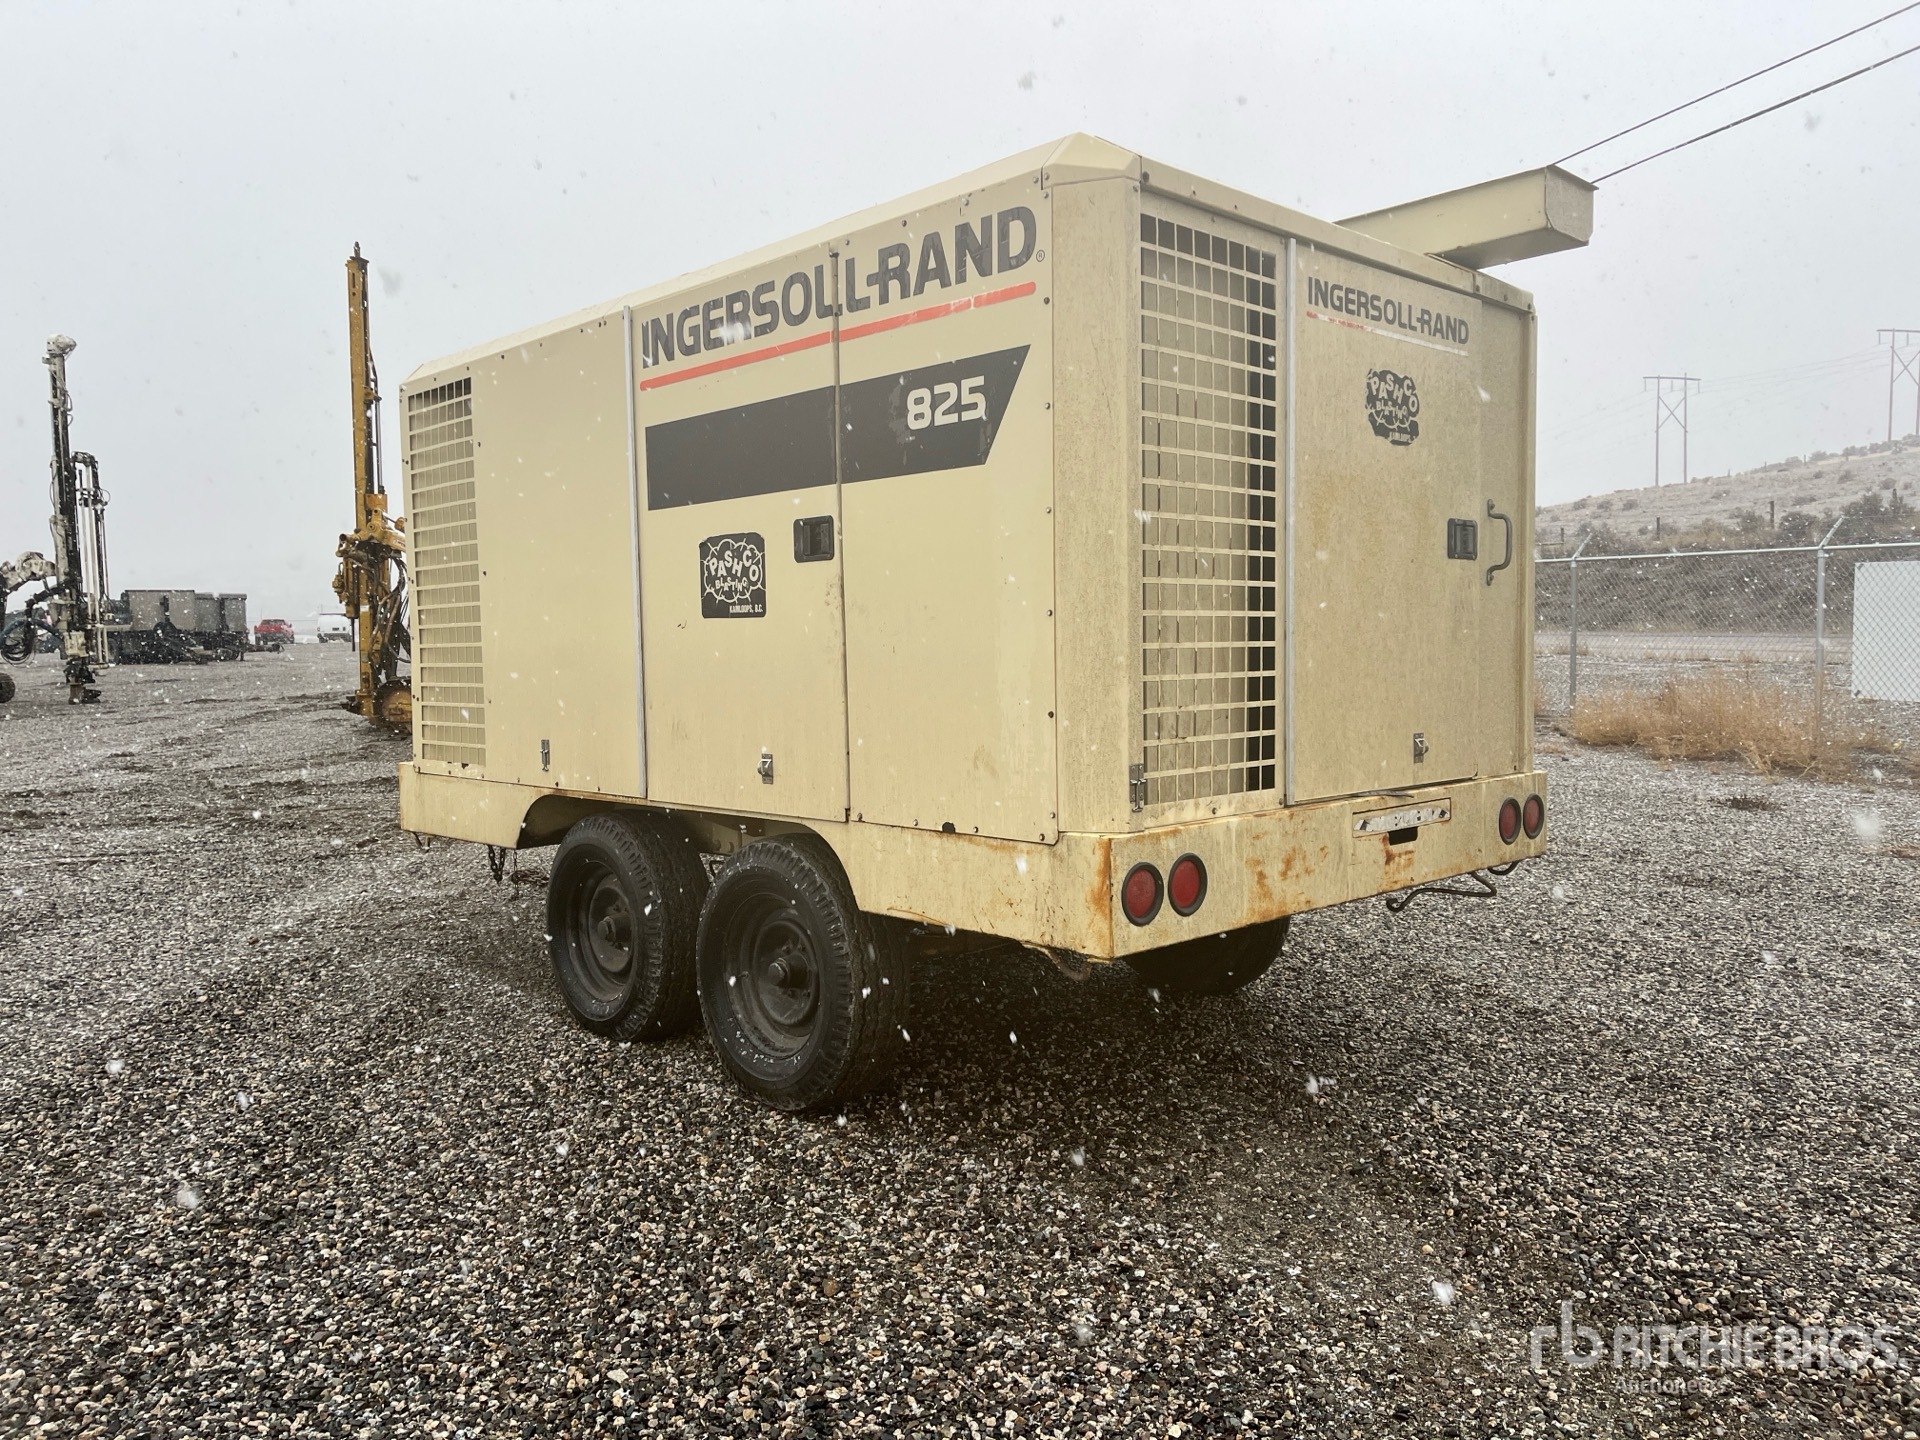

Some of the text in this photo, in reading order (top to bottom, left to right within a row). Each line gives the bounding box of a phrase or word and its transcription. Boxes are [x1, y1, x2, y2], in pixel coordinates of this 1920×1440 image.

[642, 206, 1037, 369] INGERSOLL-RAND
[1308, 276, 1469, 345] INGERSOLL-RAND
[906, 375, 987, 430] 825
[1371, 374, 1418, 413] PASHCO
[709, 550, 759, 582] PASHCO
[715, 576, 748, 592] BLASTING
